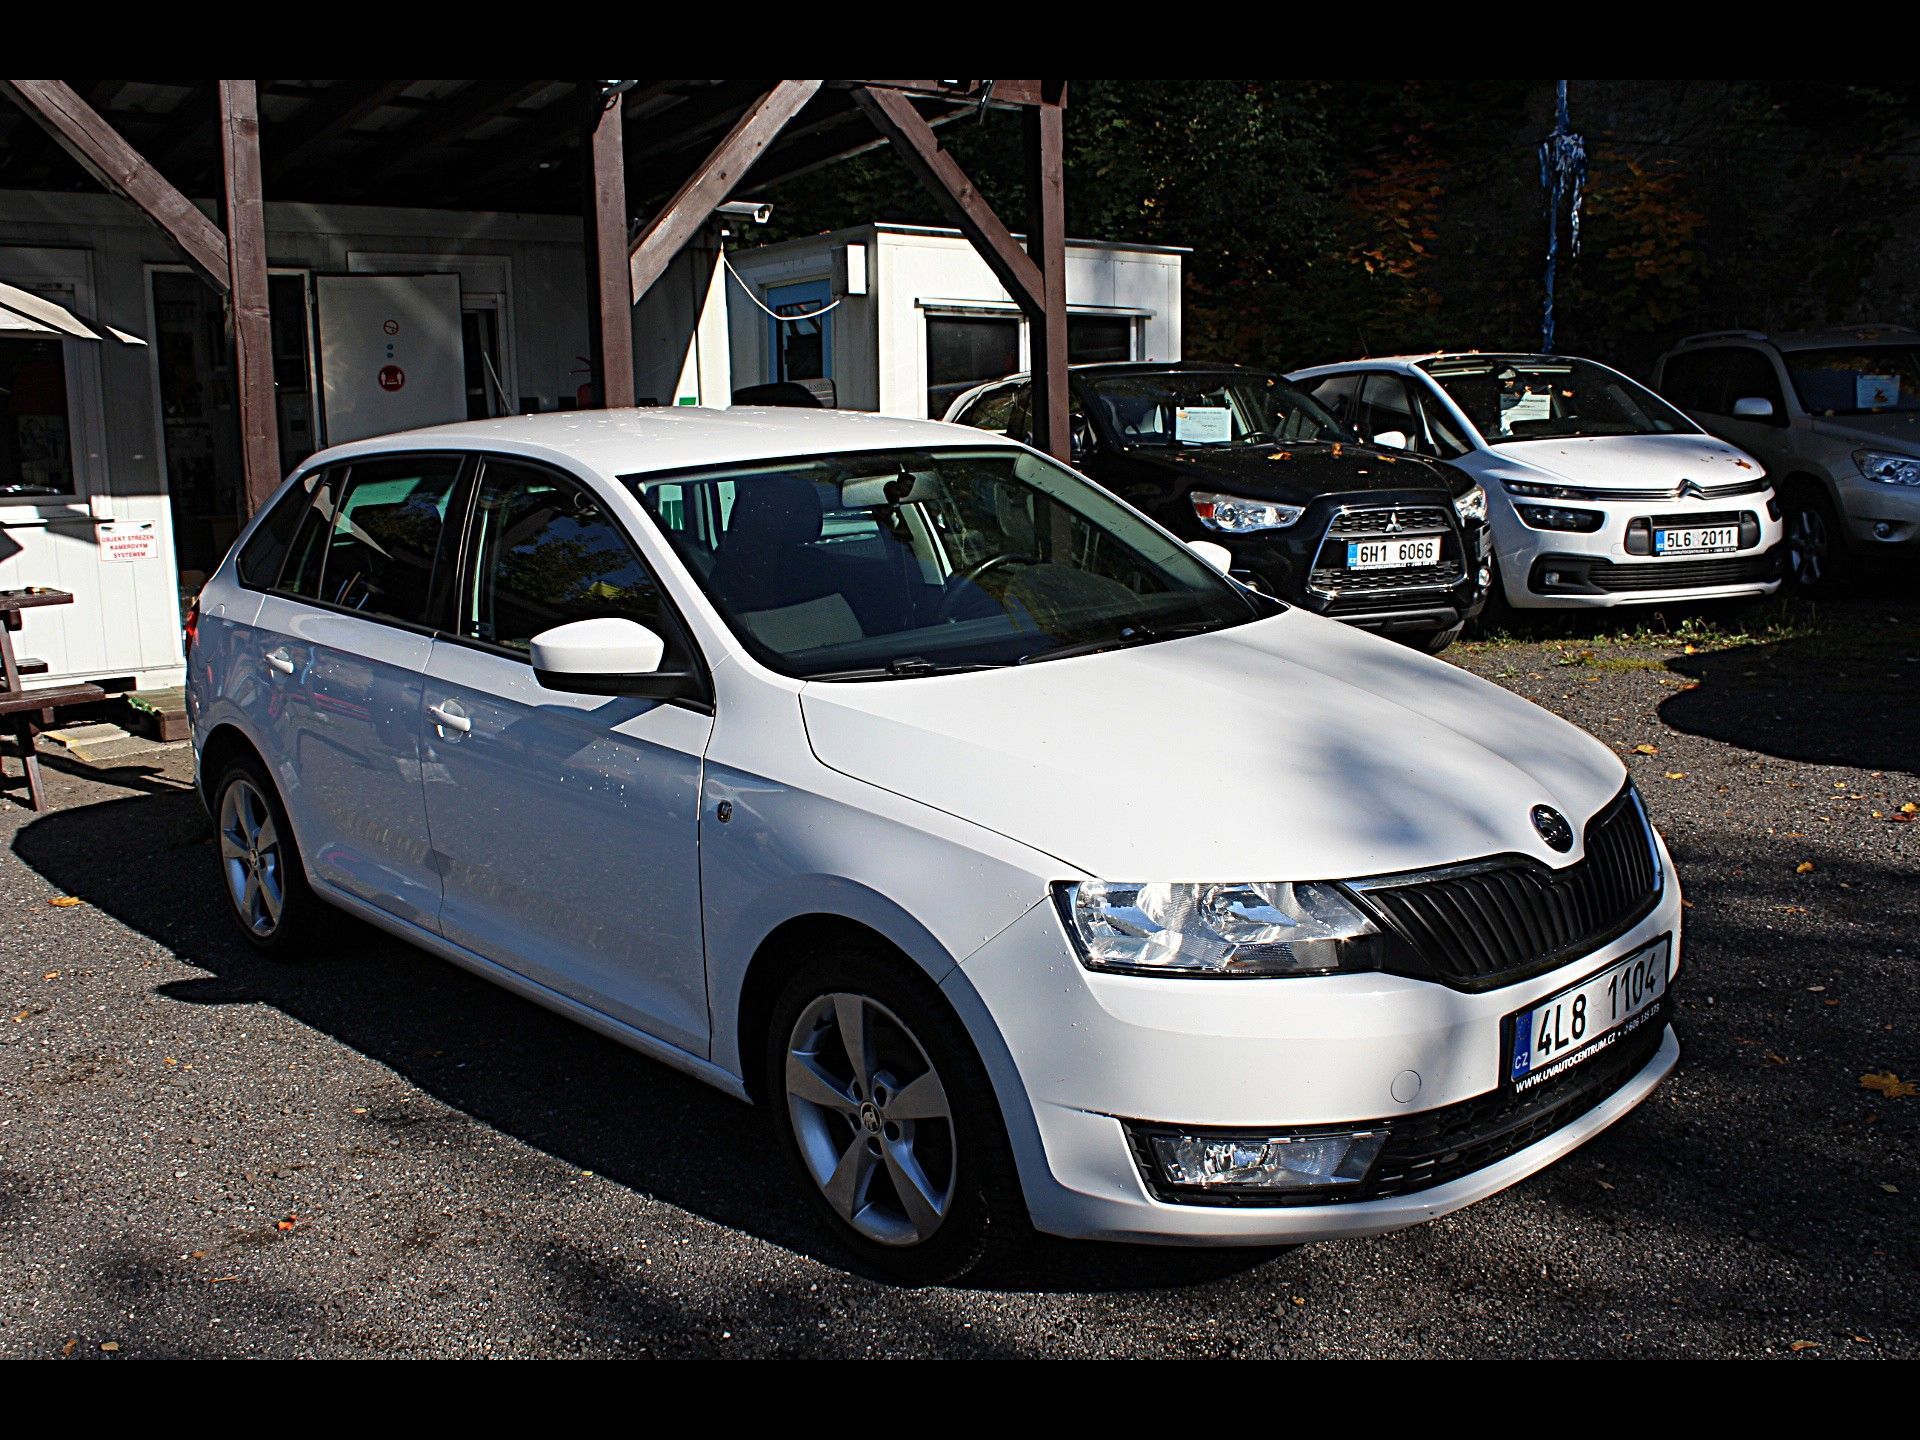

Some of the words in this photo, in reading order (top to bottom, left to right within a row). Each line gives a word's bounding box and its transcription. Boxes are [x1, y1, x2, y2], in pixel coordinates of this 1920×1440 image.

[1667, 532, 1691, 547] 5L6
[1701, 530, 1731, 546] 2011
[1361, 545, 1387, 562] 6H1
[1400, 542, 1433, 560] 6066
[1537, 994, 1587, 1056] 4L8
[1607, 952, 1656, 1020] 1104
[1515, 1051, 1529, 1070] CZ
[1515, 1032, 1616, 1094] WWW.UVAUTOCENTRUM.CZ
